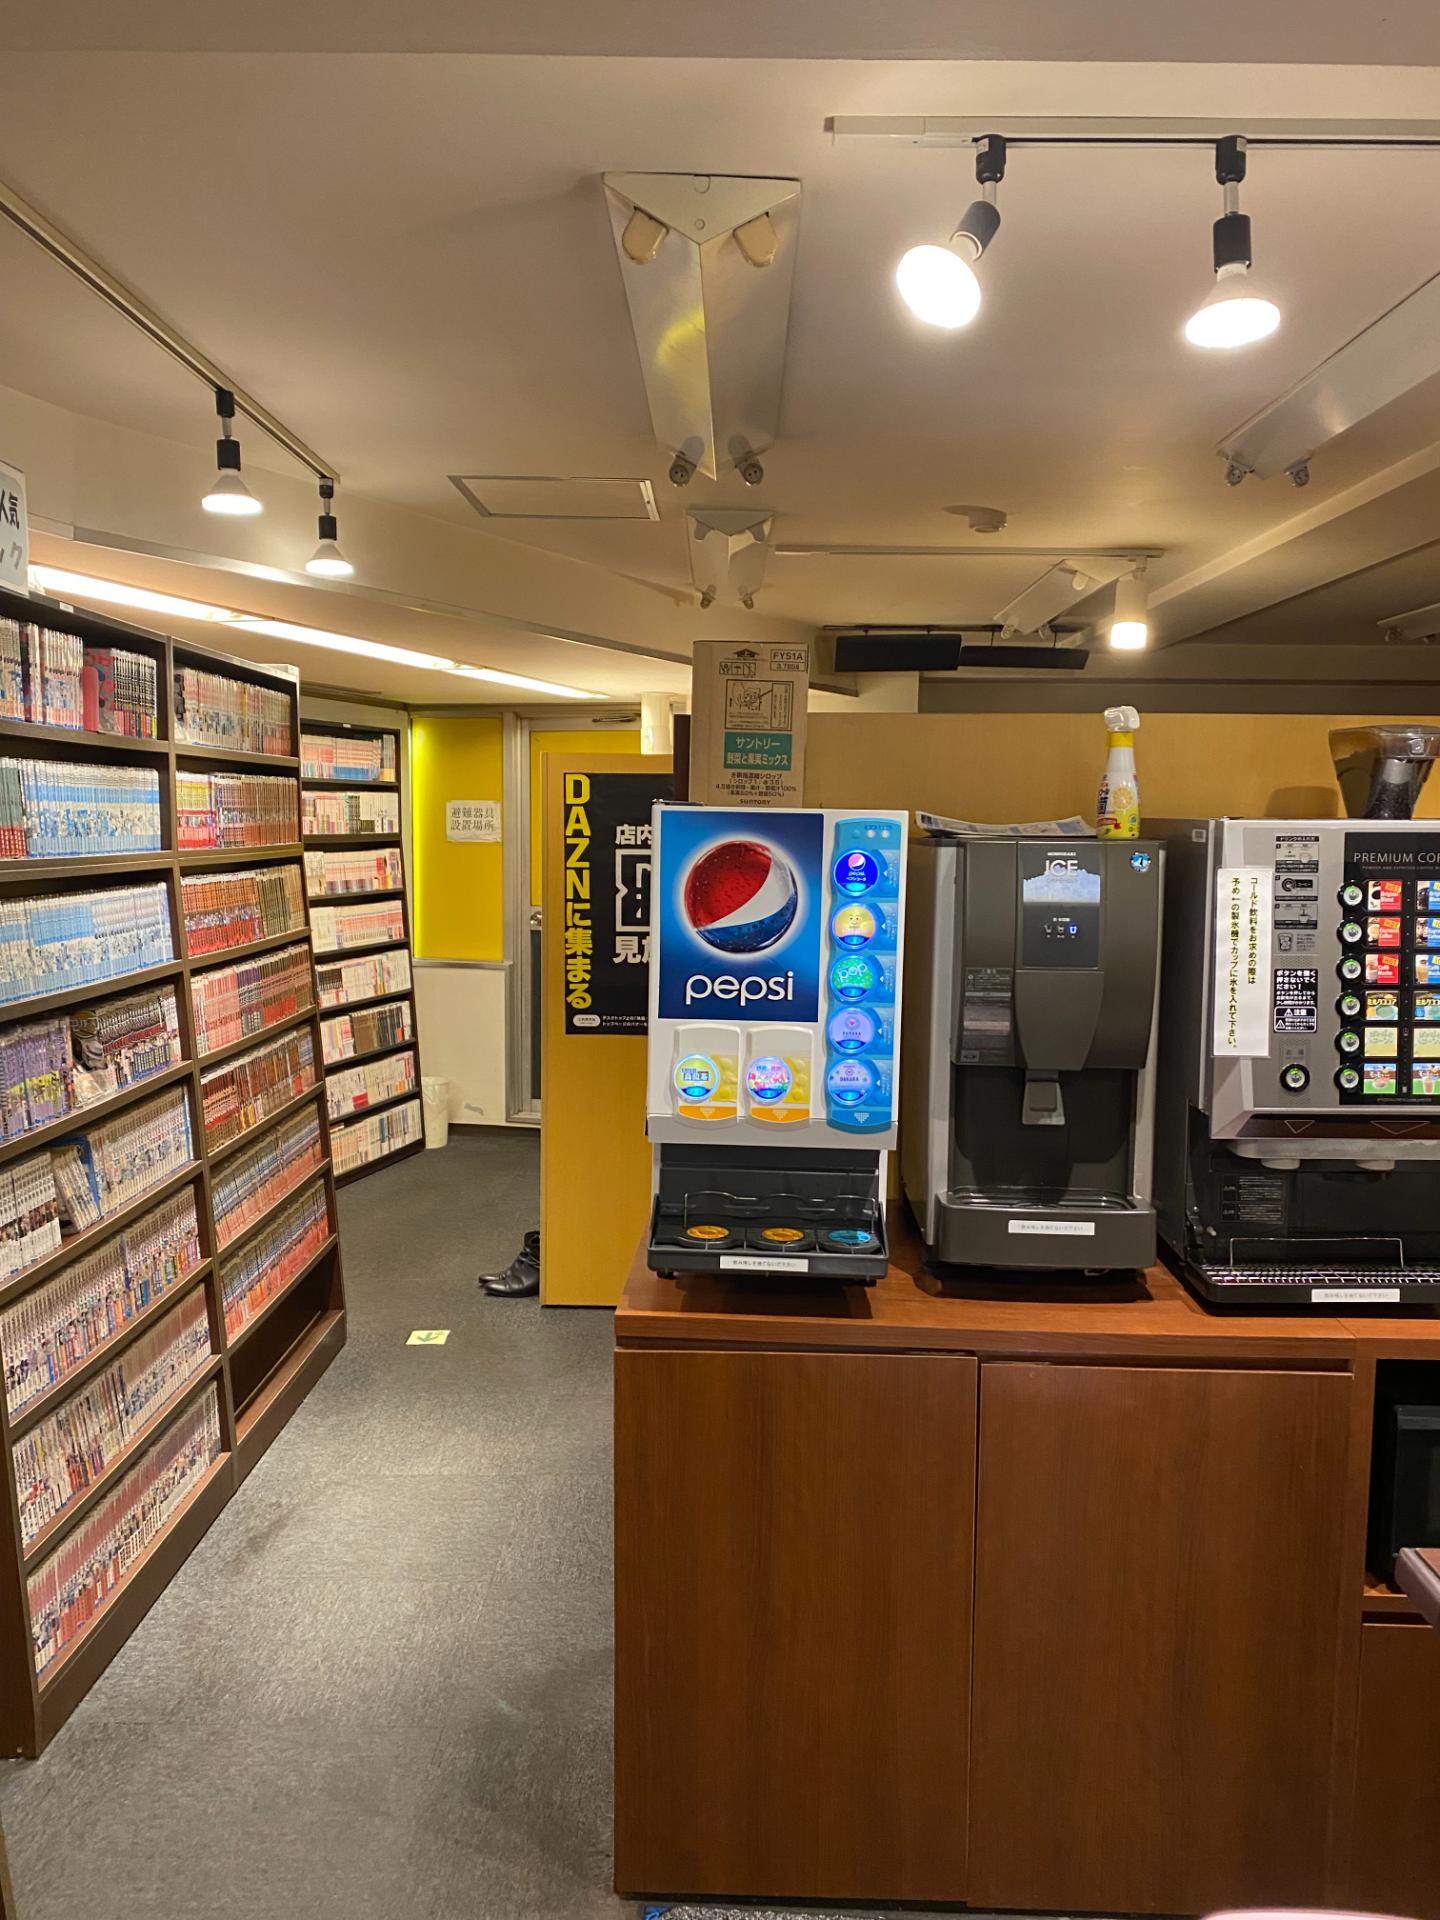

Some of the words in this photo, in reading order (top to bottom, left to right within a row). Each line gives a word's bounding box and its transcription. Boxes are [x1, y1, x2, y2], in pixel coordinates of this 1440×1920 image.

[773, 651, 803, 660] FYS1A
[735, 736, 781, 749] サントリー
[726, 752, 789, 766] 野菜と果実ミックス
[450, 807, 495, 819] 避難器具
[450, 819, 496, 832] 設置場所
[615, 824, 652, 845] 店内
[1353, 852, 1413, 863] PREMIUM
[1045, 859, 1078, 876] ICE
[565, 773, 593, 1009] DAZNに集まる
[1247, 877, 1258, 985] コールド飲料をお求めの際は
[838, 963, 868, 983] pop
[685, 971, 794, 1007] pepsi
